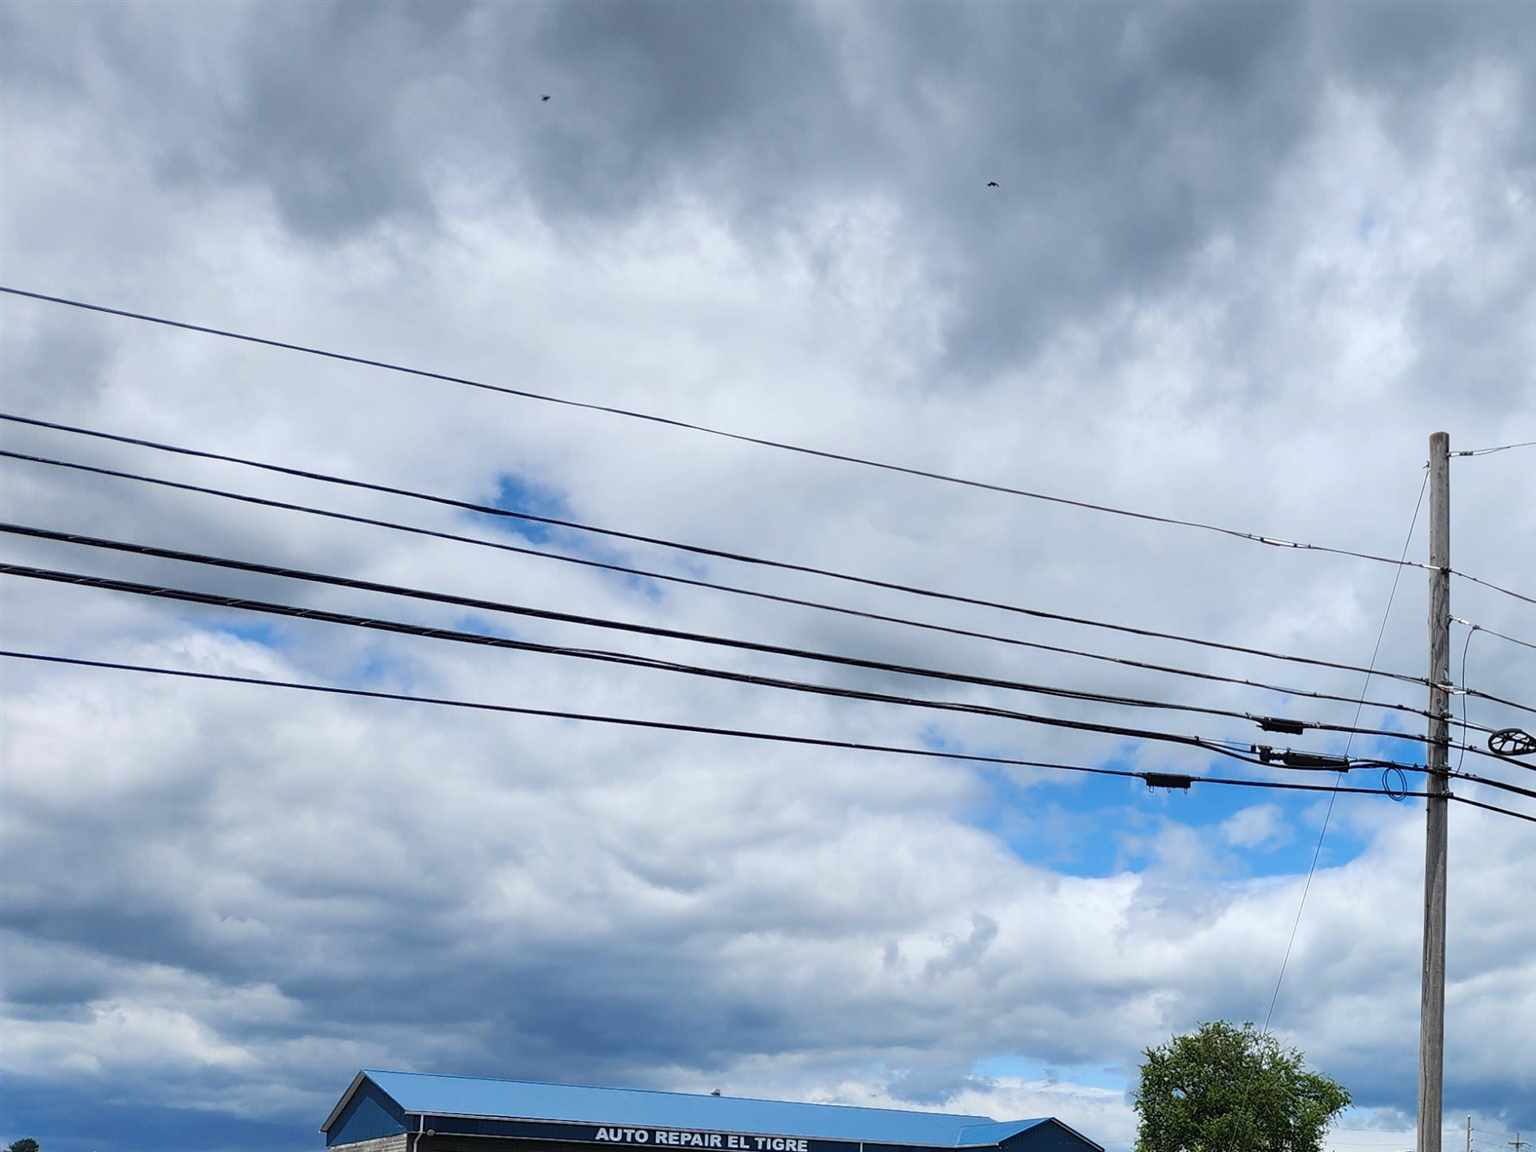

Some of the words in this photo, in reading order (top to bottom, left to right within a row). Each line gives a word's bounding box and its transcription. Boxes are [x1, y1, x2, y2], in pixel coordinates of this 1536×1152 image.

[595, 1127, 649, 1143] AUTO
[655, 1130, 722, 1148] REPAIR
[727, 1135, 750, 1149] EL
[754, 1137, 809, 1152] TIGRE
